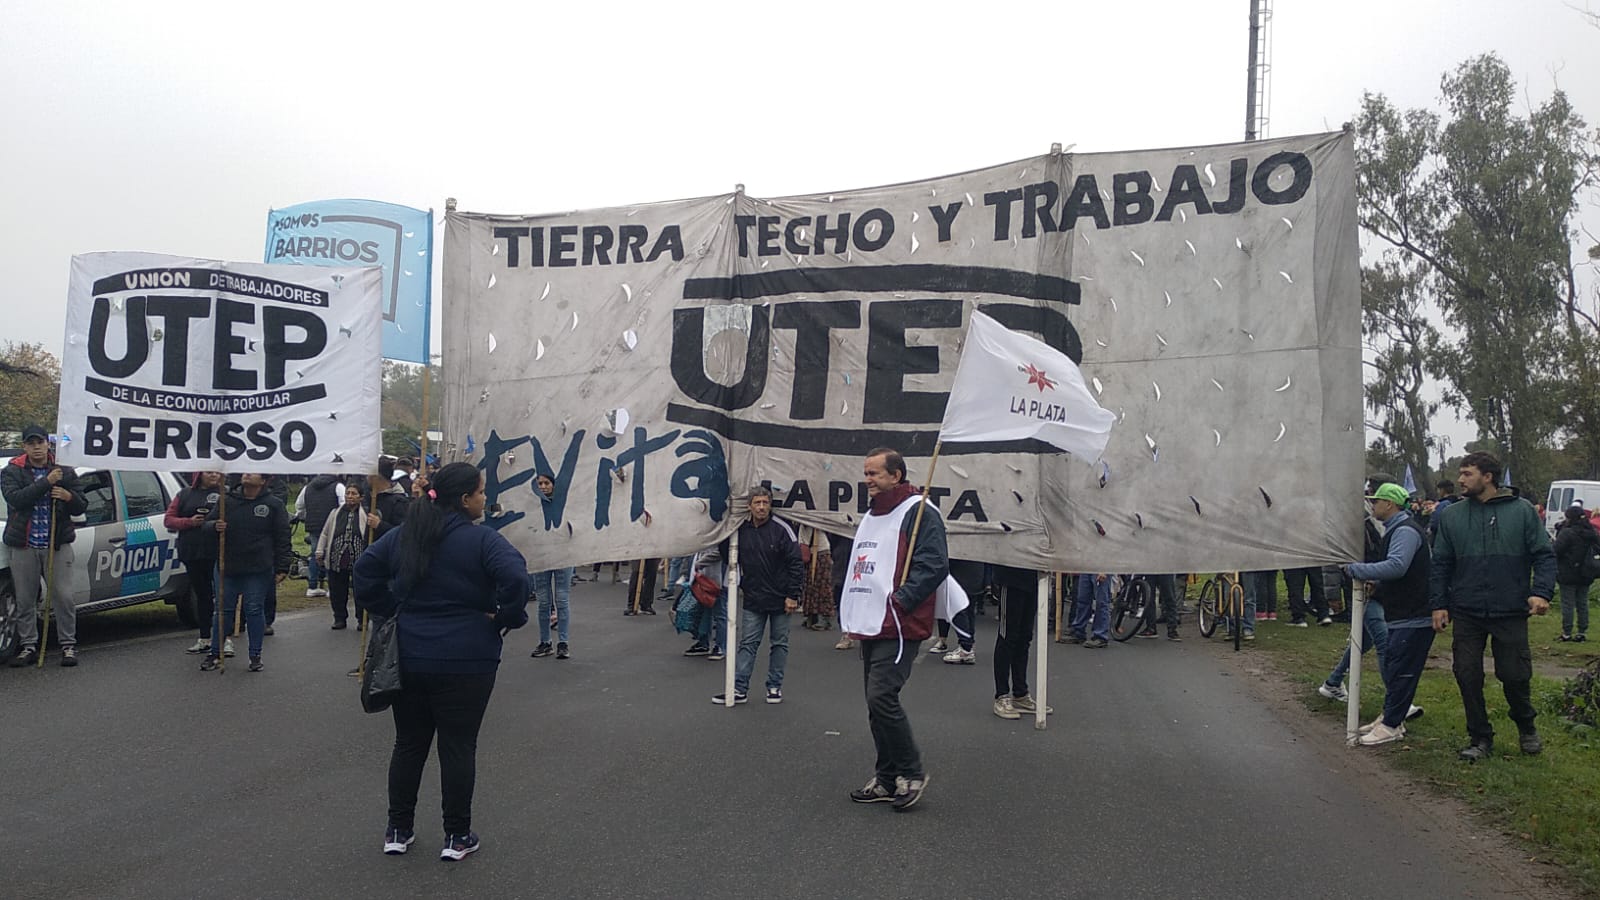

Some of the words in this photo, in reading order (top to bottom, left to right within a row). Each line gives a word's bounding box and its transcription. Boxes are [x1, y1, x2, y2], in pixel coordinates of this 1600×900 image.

[493, 225, 685, 267] TIERRA
[735, 207, 895, 257] TECHO
[928, 202, 963, 242] Y
[984, 151, 1313, 241] TRABAJO
[274, 236, 380, 263] BARRIOS
[88, 295, 327, 390] UTEP
[112, 386, 129, 400] DE
[133, 390, 150, 405] LA
[233, 392, 290, 411] POPULAR
[1010, 396, 1026, 416] LA
[1029, 400, 1066, 423] PLATA
[84, 415, 316, 461] BERISSO
[828, 481, 988, 522] PLTA
[95, 545, 160, 580] POICIA
